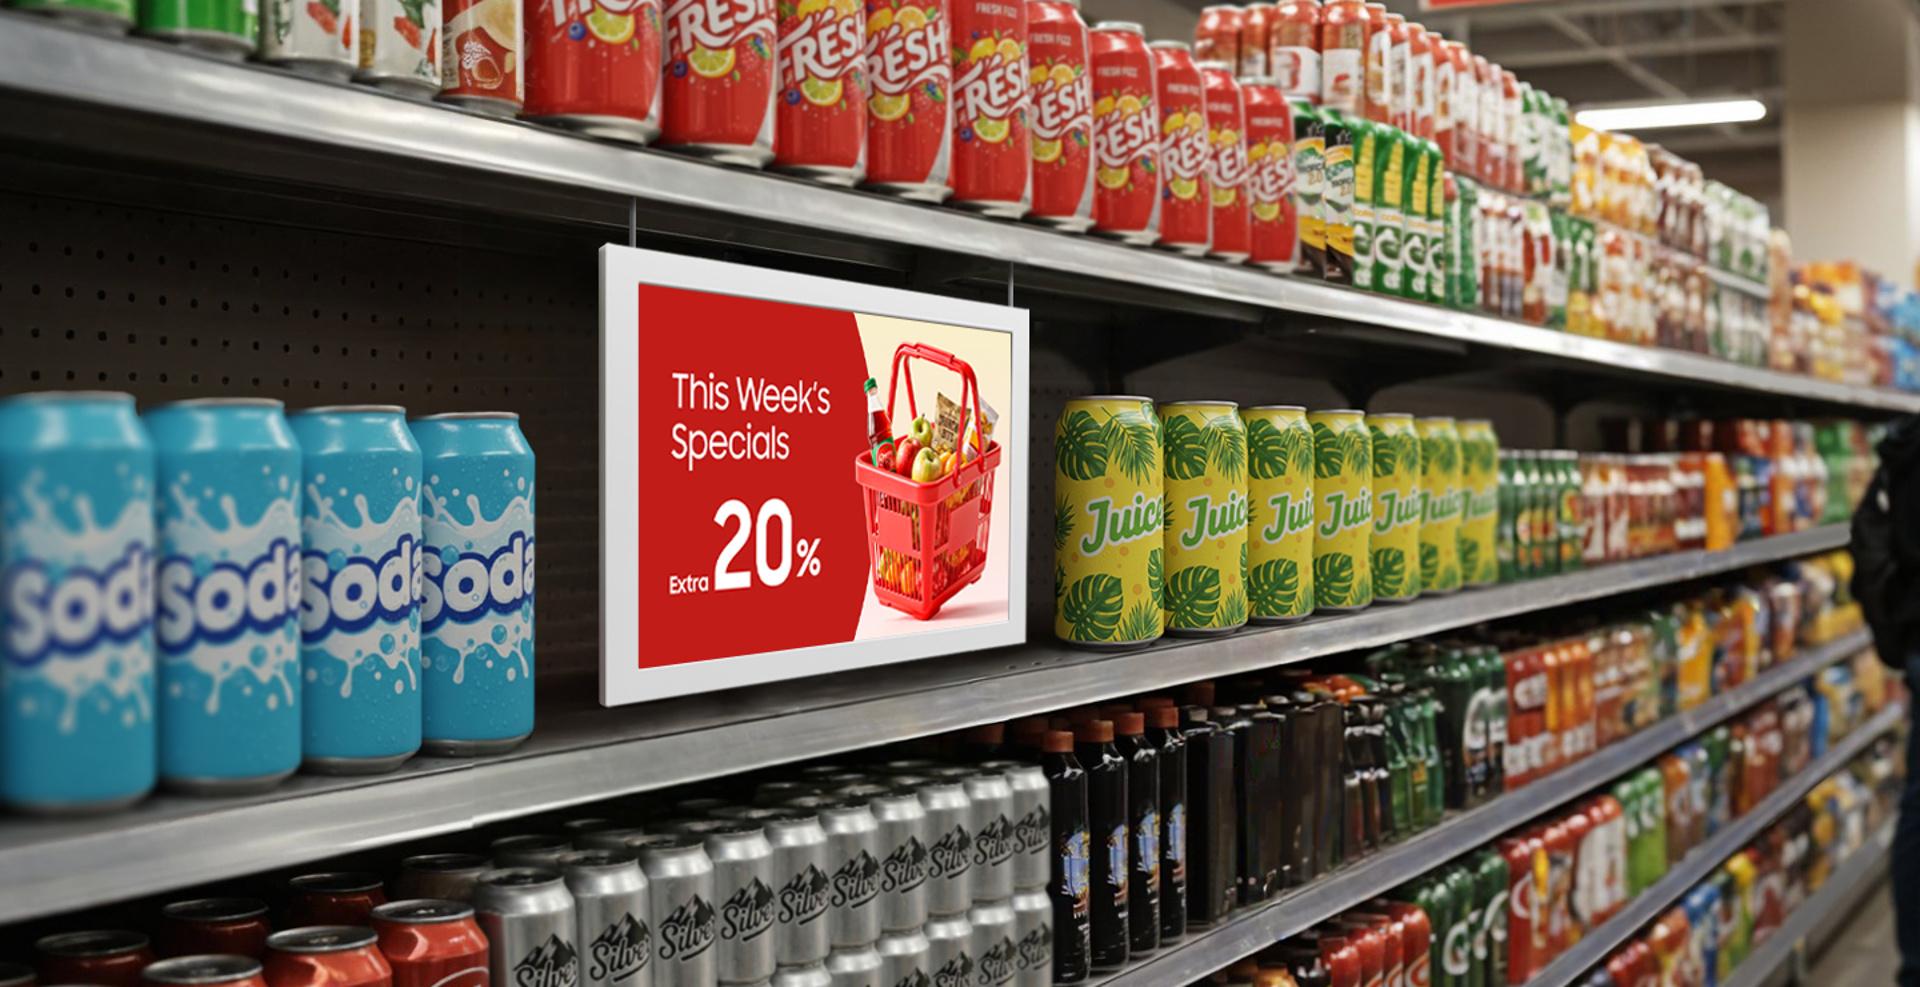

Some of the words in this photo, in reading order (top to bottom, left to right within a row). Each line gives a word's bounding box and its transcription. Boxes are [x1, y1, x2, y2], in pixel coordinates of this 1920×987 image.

[671, 372, 730, 411] This
[736, 376, 831, 415] Week's
[671, 422, 790, 472] Specials
[669, 573, 709, 595] Extra
[713, 498, 793, 591] 20
